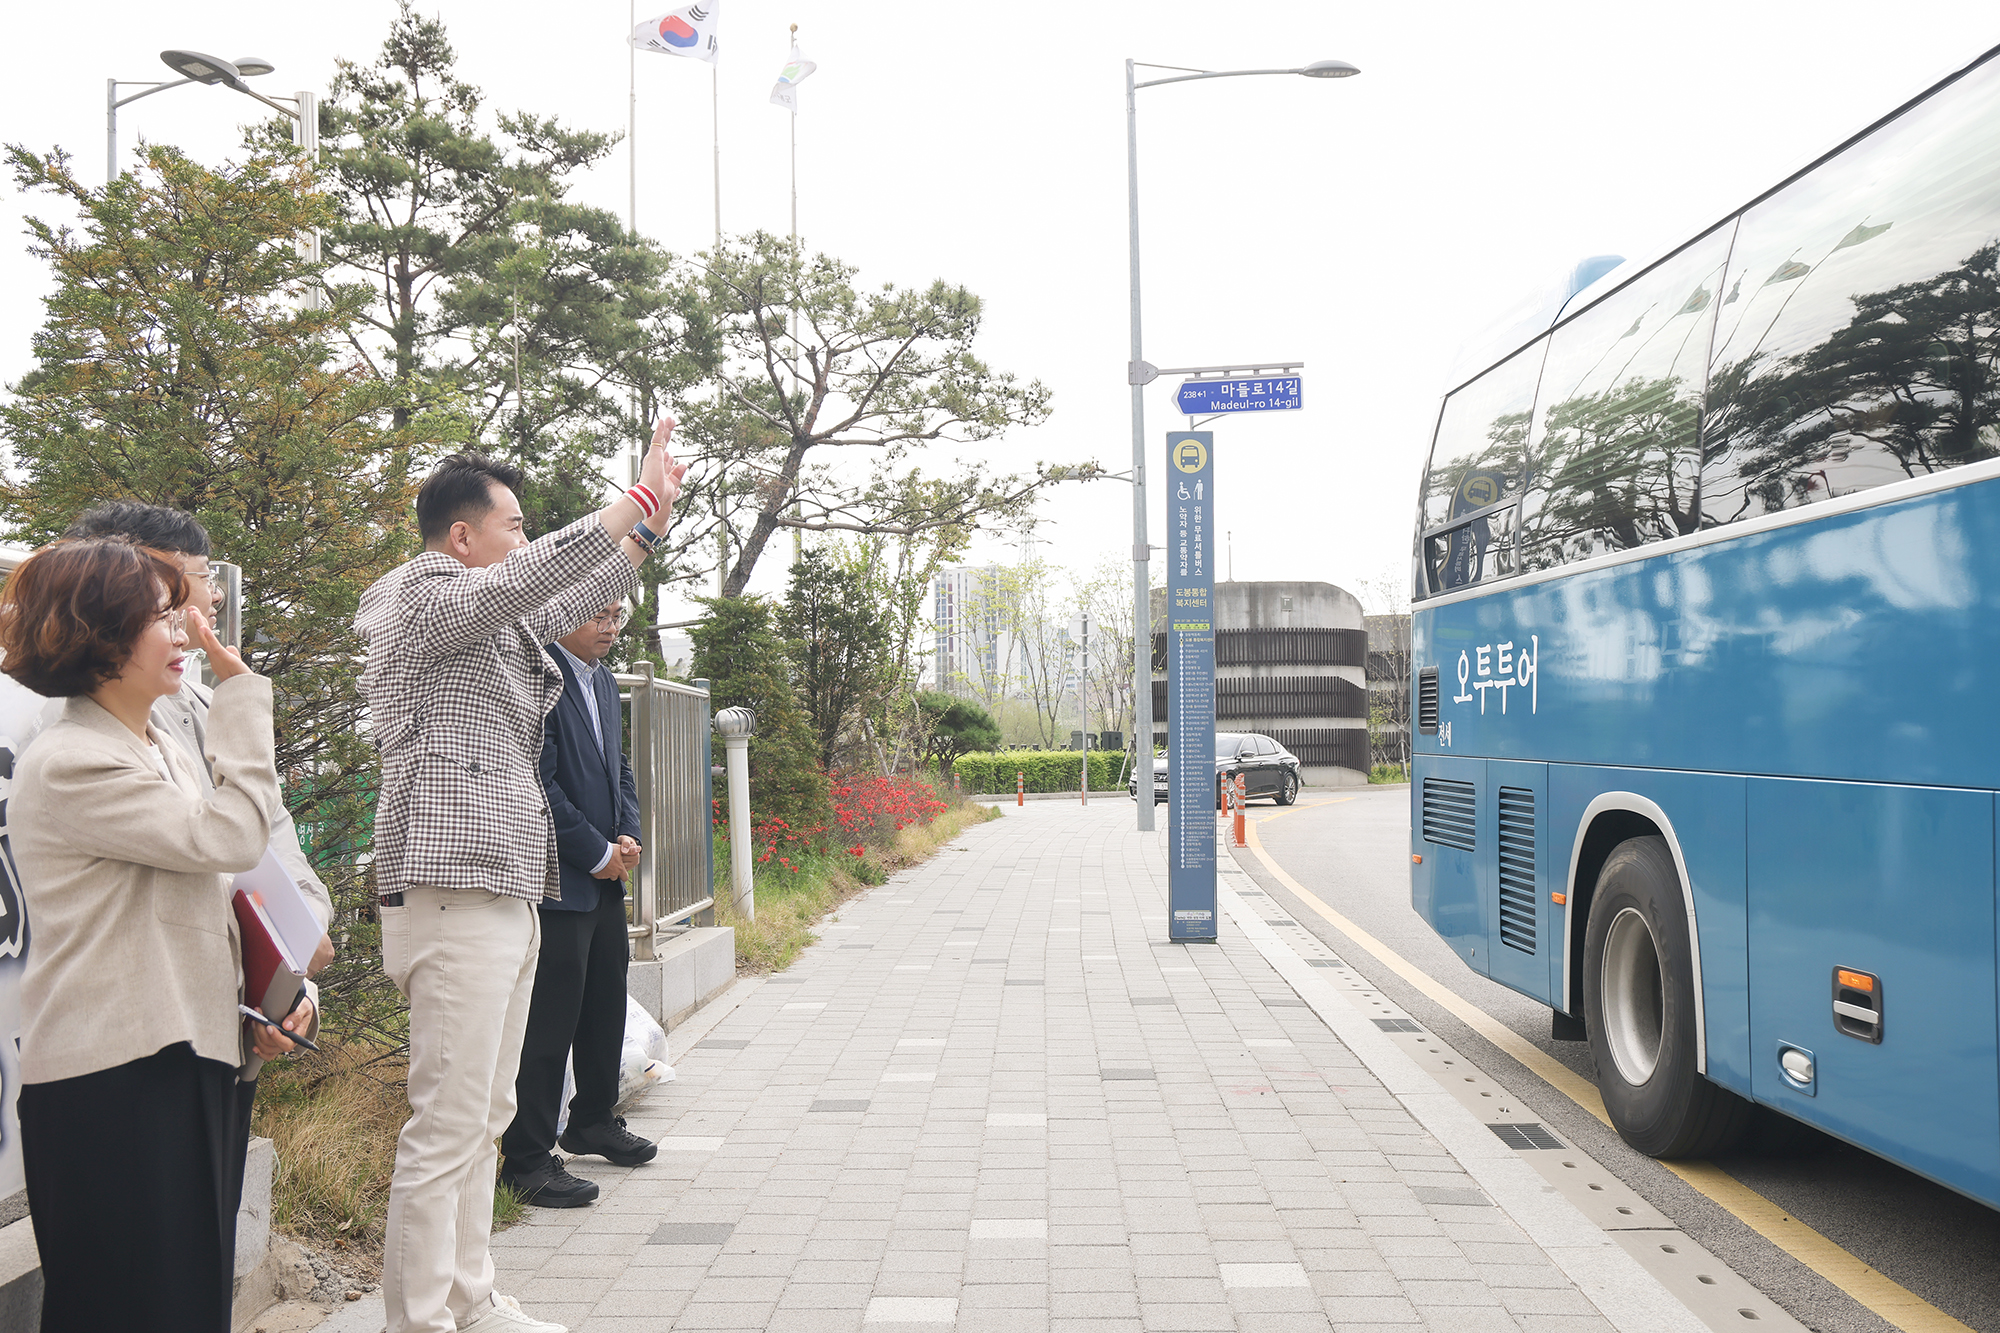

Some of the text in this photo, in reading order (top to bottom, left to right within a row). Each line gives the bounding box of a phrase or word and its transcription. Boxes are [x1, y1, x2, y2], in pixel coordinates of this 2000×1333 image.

[1221, 380, 1298, 397] 마들로14길
[1210, 397, 1298, 410] Madeul-ro 14-gil
[1194, 506, 1202, 523] 위한
[1175, 588, 1208, 598] 도봉통합
[1175, 598, 1208, 608] 복지센터
[1453, 634, 1539, 716] 오투투어
[1438, 721, 1452, 748] 전세
